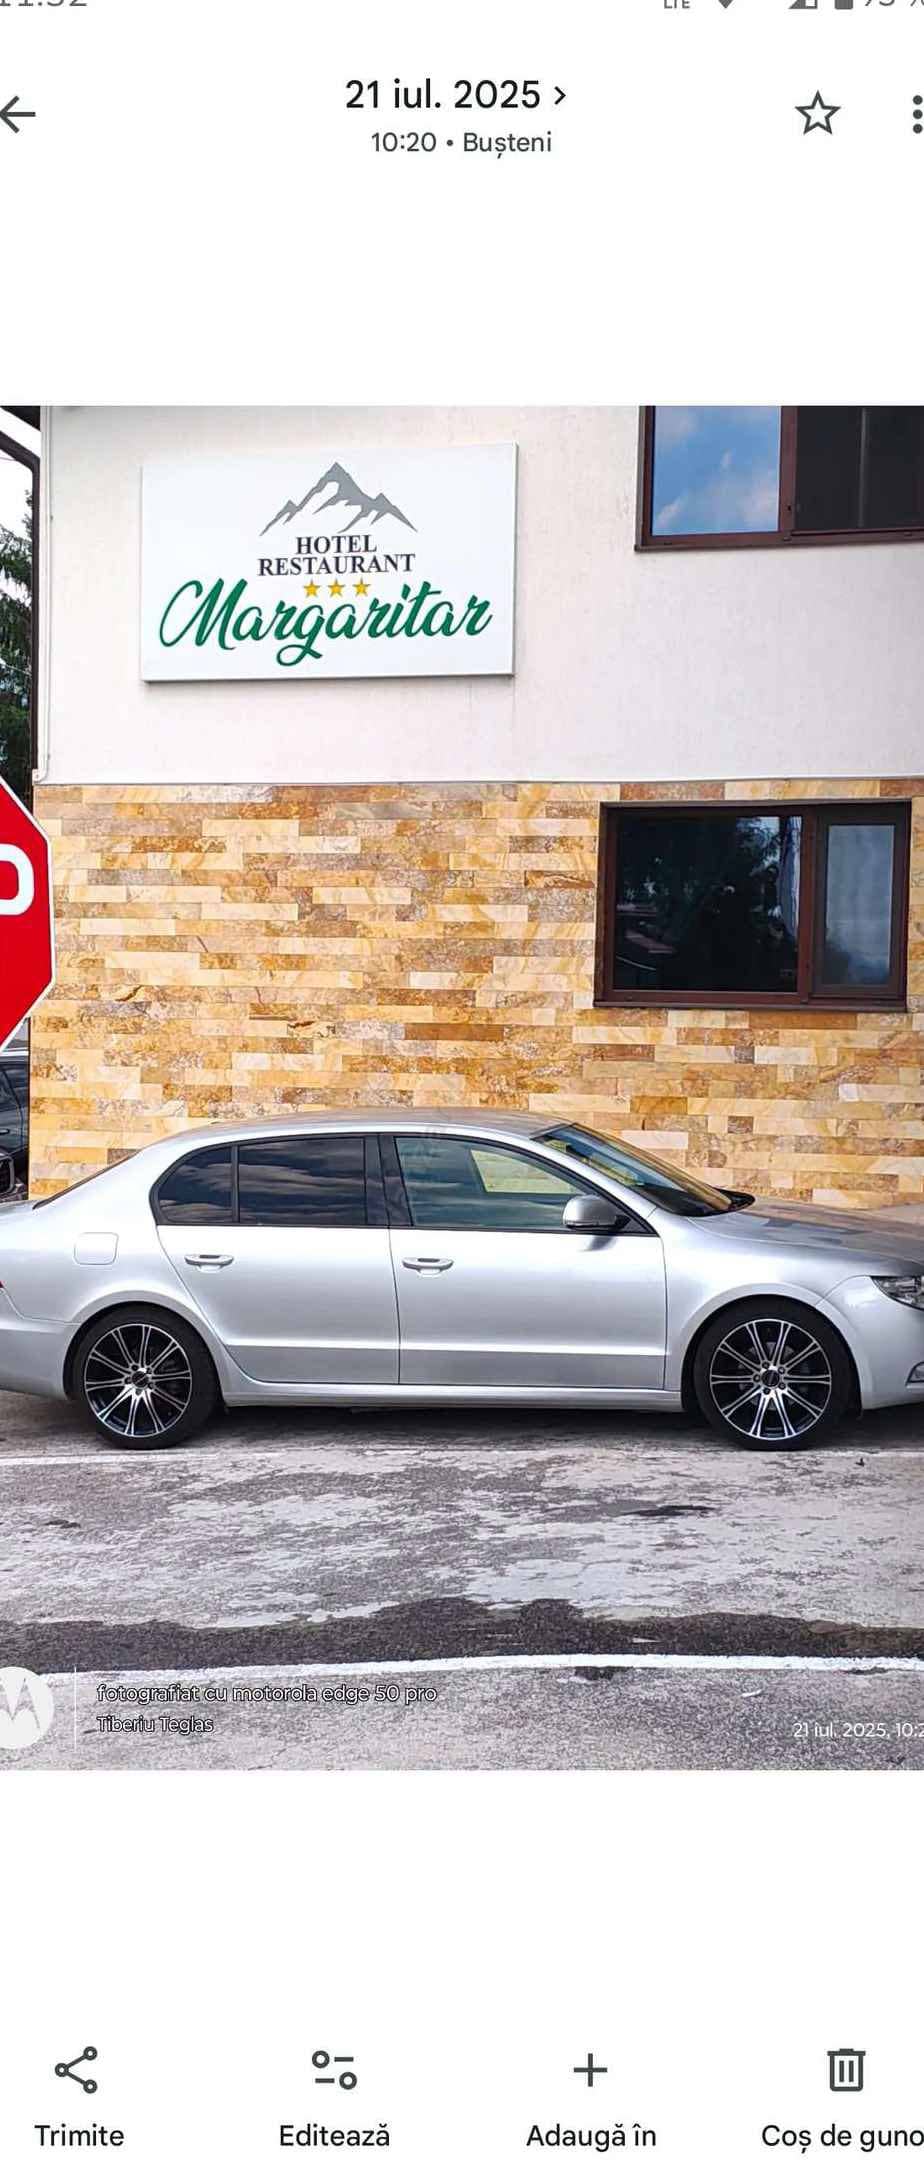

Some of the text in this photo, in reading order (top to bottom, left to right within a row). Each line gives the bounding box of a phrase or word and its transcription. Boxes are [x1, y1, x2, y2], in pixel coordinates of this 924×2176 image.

[295, 534, 377, 555] HOTEL
[257, 553, 416, 577] RESTAURANT
[159, 577, 493, 667] Margaritar
